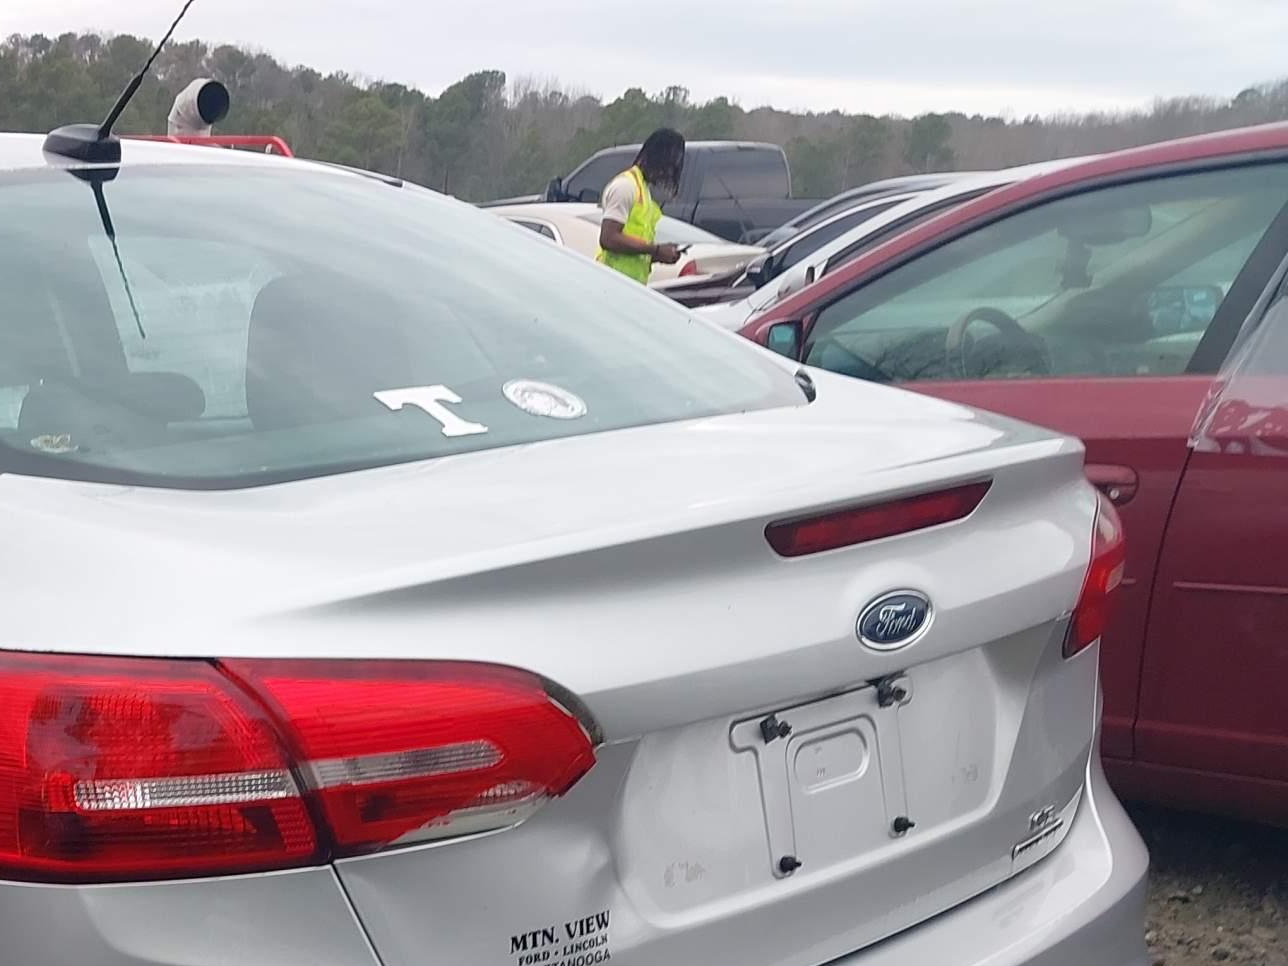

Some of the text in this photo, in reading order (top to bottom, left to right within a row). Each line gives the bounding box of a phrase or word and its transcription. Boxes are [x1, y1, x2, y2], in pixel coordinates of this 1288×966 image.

[373, 384, 488, 437] T
[876, 602, 917, 636] Ford
[510, 910, 611, 954] MTN. VIEW
[518, 950, 550, 966] FORD
[563, 933, 608, 957] LINCOLN
